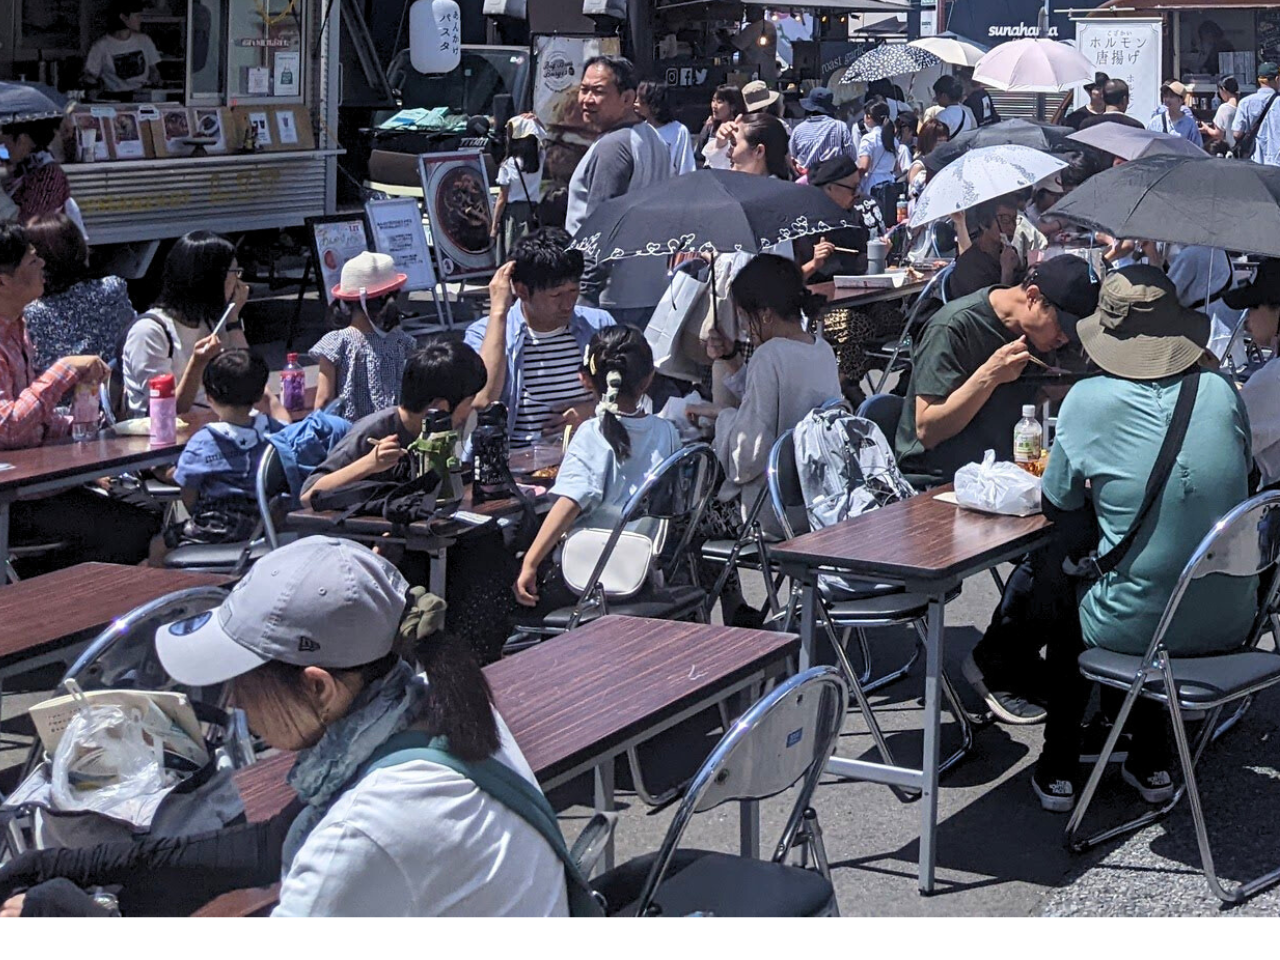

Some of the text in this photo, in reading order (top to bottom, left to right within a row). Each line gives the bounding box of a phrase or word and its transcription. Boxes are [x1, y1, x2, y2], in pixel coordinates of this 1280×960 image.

[440, 13, 451, 51] パスタ
[988, 21, 1059, 37] sunahaa
[1090, 36, 1147, 49] ホルモン
[1096, 49, 1140, 66] 唐揚げ
